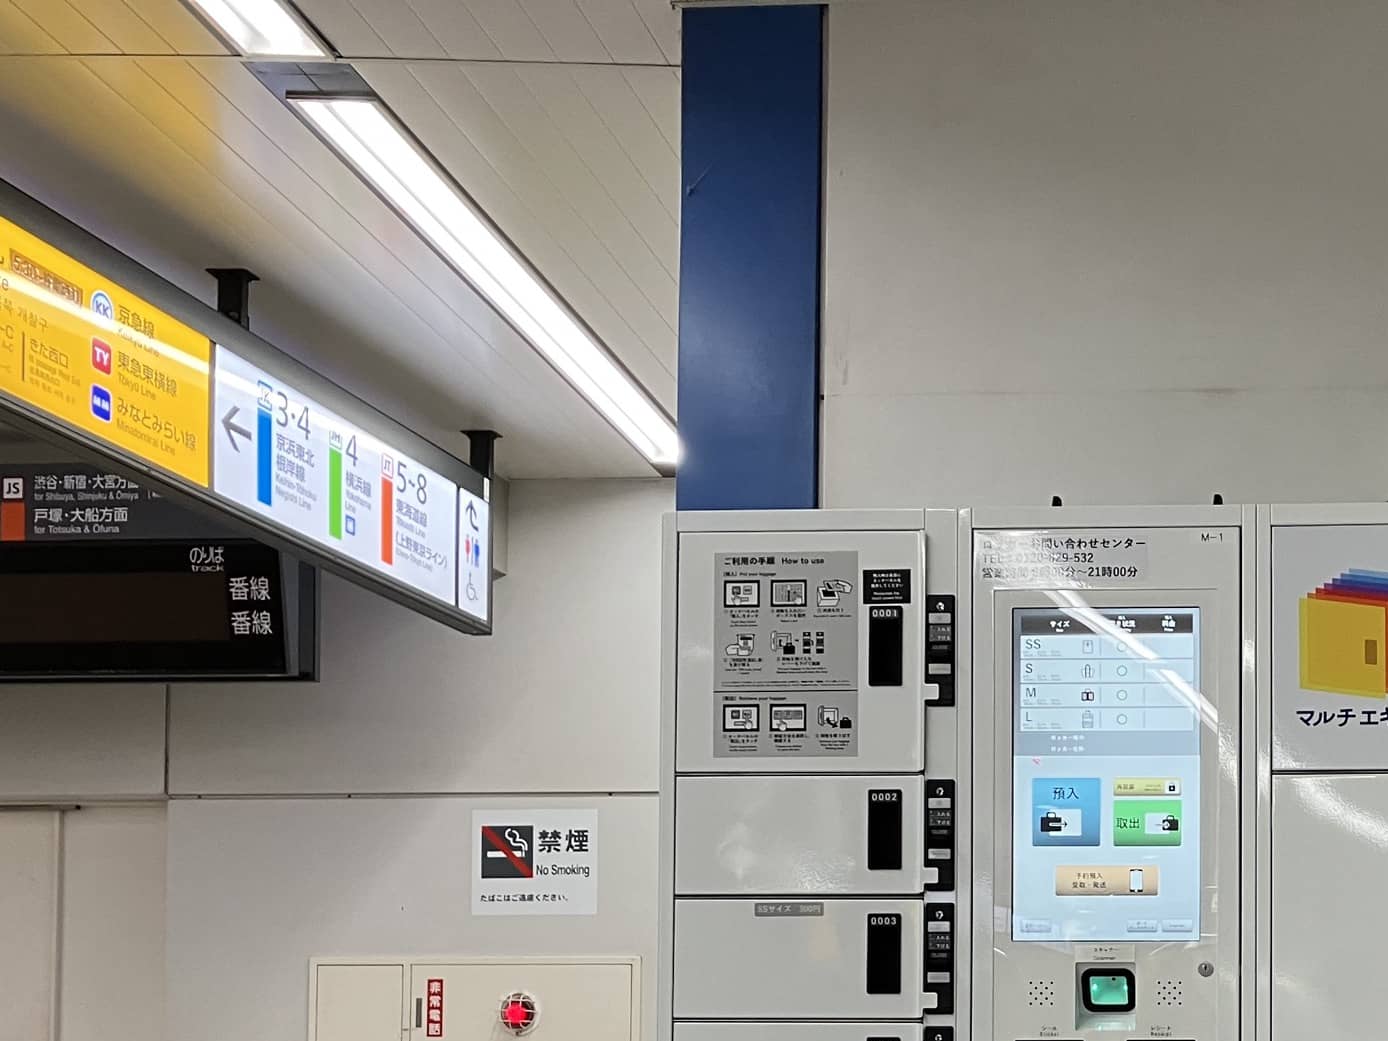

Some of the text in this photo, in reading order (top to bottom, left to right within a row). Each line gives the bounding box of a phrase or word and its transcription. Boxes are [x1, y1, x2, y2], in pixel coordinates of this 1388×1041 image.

[94, 346, 110, 366] TY
[117, 351, 177, 397] 東急東横線
[116, 397, 197, 450] みなとみらい線
[346, 435, 358, 467] 4
[6, 482, 20, 494] JS
[34, 507, 129, 522] 戸塚・大船方面
[189, 546, 225, 564] のりば
[228, 576, 271, 601] 番線
[872, 609, 898, 618] 0001
[231, 610, 273, 635] 番線
[1025, 638, 1041, 650] SS
[1025, 663, 1033, 674] S
[1025, 687, 1037, 698] M
[1025, 711, 1033, 722] L
[871, 793, 897, 801] 0002
[1053, 787, 1080, 800] 預入
[1116, 817, 1140, 829] 取出
[538, 829, 590, 854] 禁煙
[536, 864, 590, 878] No Smoking
[870, 916, 897, 925] 0003
